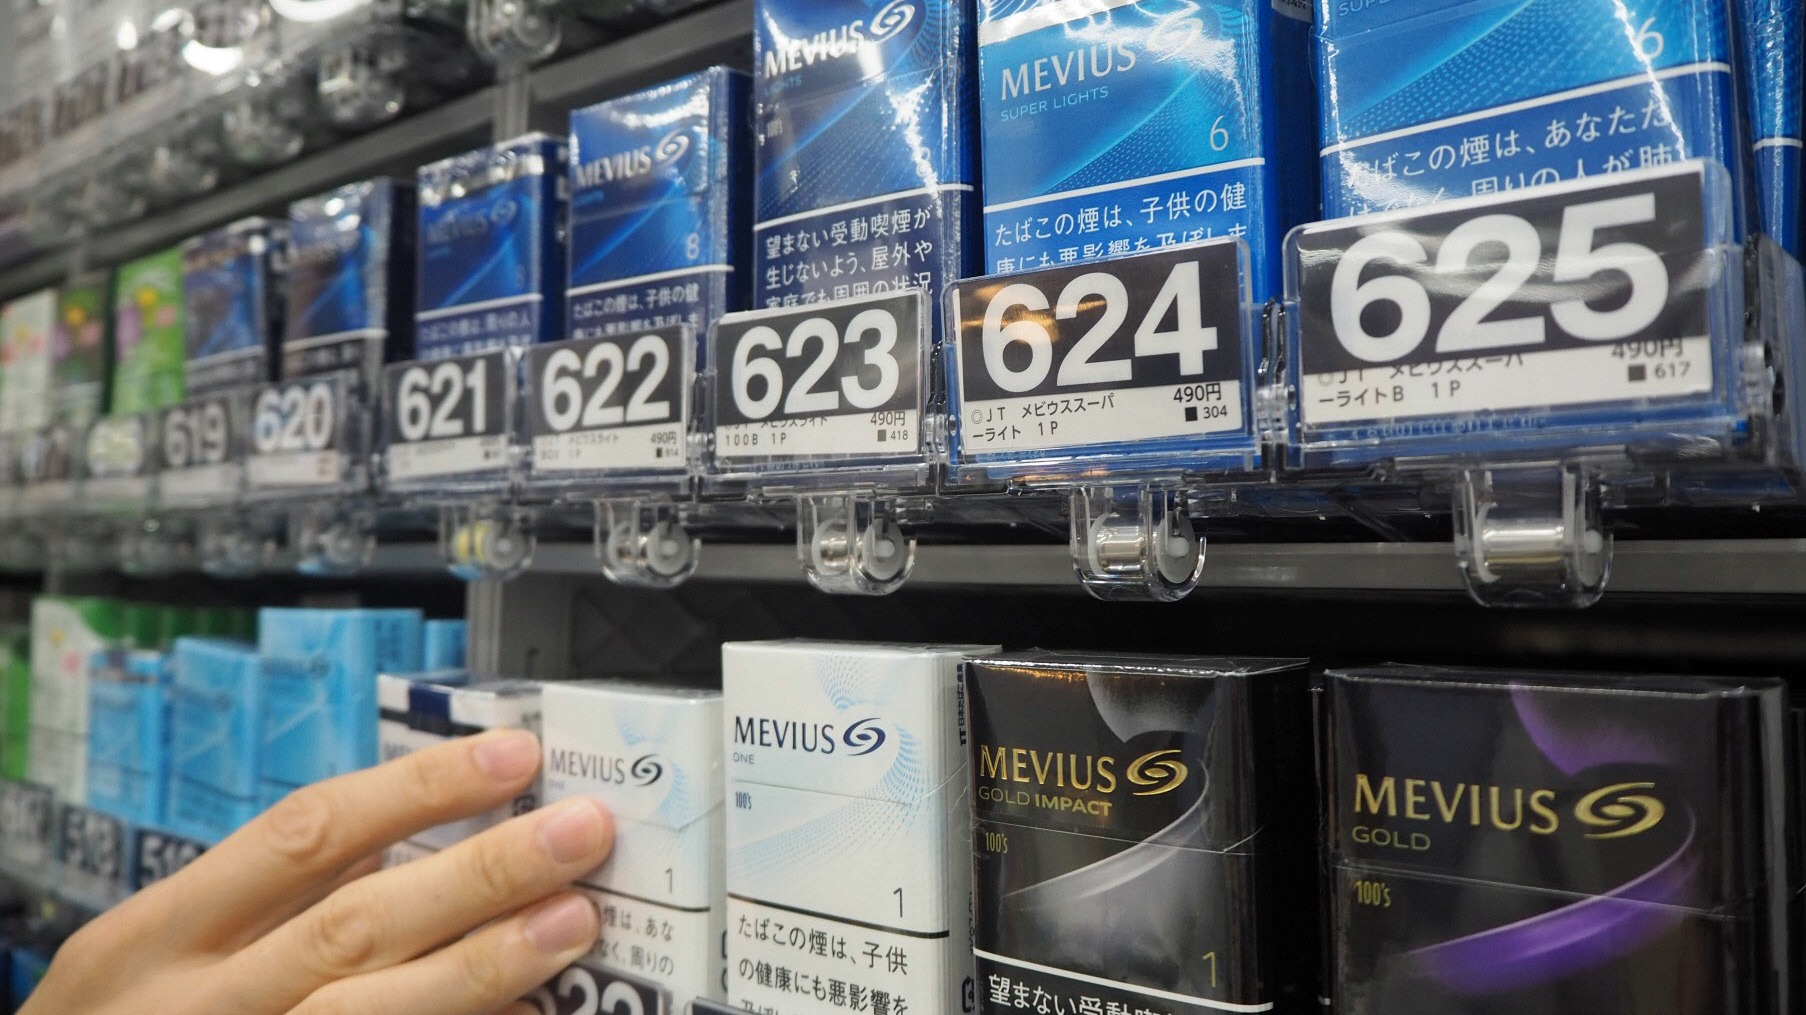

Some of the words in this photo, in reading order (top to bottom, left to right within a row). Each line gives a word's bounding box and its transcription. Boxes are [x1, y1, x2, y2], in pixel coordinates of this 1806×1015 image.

[764, 20, 864, 78] MEVIUS
[1636, 17, 1664, 59] 6
[1001, 42, 1136, 100] MEVIUS
[1001, 102, 1048, 122] SUPER
[1053, 86, 1109, 109] LIGHTS
[1210, 115, 1229, 151] 6
[576, 146, 651, 188] MEVIUS
[766, 204, 933, 260] 望まない受動喫煙が
[995, 181, 1247, 247] たばこの煙は、子供の健
[685, 232, 700, 260] 8
[766, 240, 932, 290] 生じないよう、屋外や
[1331, 192, 1669, 362] 625
[982, 260, 1218, 393] 624
[732, 308, 899, 420] 623
[1612, 337, 1684, 358] 490円
[542, 334, 670, 431] 622
[1655, 361, 1691, 378] 617
[398, 357, 486, 441] 621
[1022, 392, 1115, 418] メビウススーパ
[1173, 383, 1222, 403] 490円
[1432, 380, 1461, 398] 1P
[255, 382, 333, 452] 620
[870, 410, 906, 426] 490円
[1038, 422, 1058, 436] 1P
[1203, 405, 1228, 419] 304
[651, 431, 677, 445] 490円
[726, 433, 758, 446] 100B
[772, 432, 787, 445] 1P
[890, 430, 908, 441] 418
[735, 716, 836, 755] MEVIUS
[550, 748, 625, 785] MEVIUS
[733, 752, 755, 765] ONE
[980, 745, 1117, 794] MEVIUS
[735, 791, 752, 809] 100's
[979, 786, 1030, 806] GOLD
[1035, 794, 1113, 817] IMPACT
[1354, 773, 1560, 836] MEVIUS
[985, 832, 1008, 854] 100's
[1351, 825, 1431, 851] GOLD
[665, 867, 673, 893] 1
[1355, 880, 1392, 908] 100's
[893, 887, 904, 918] 1
[600, 904, 674, 942] 煙は、あな
[739, 914, 908, 975] たばこの煙は、子供
[739, 957, 908, 1015] の健康にも悪影響を
[1202, 952, 1216, 988] 1
